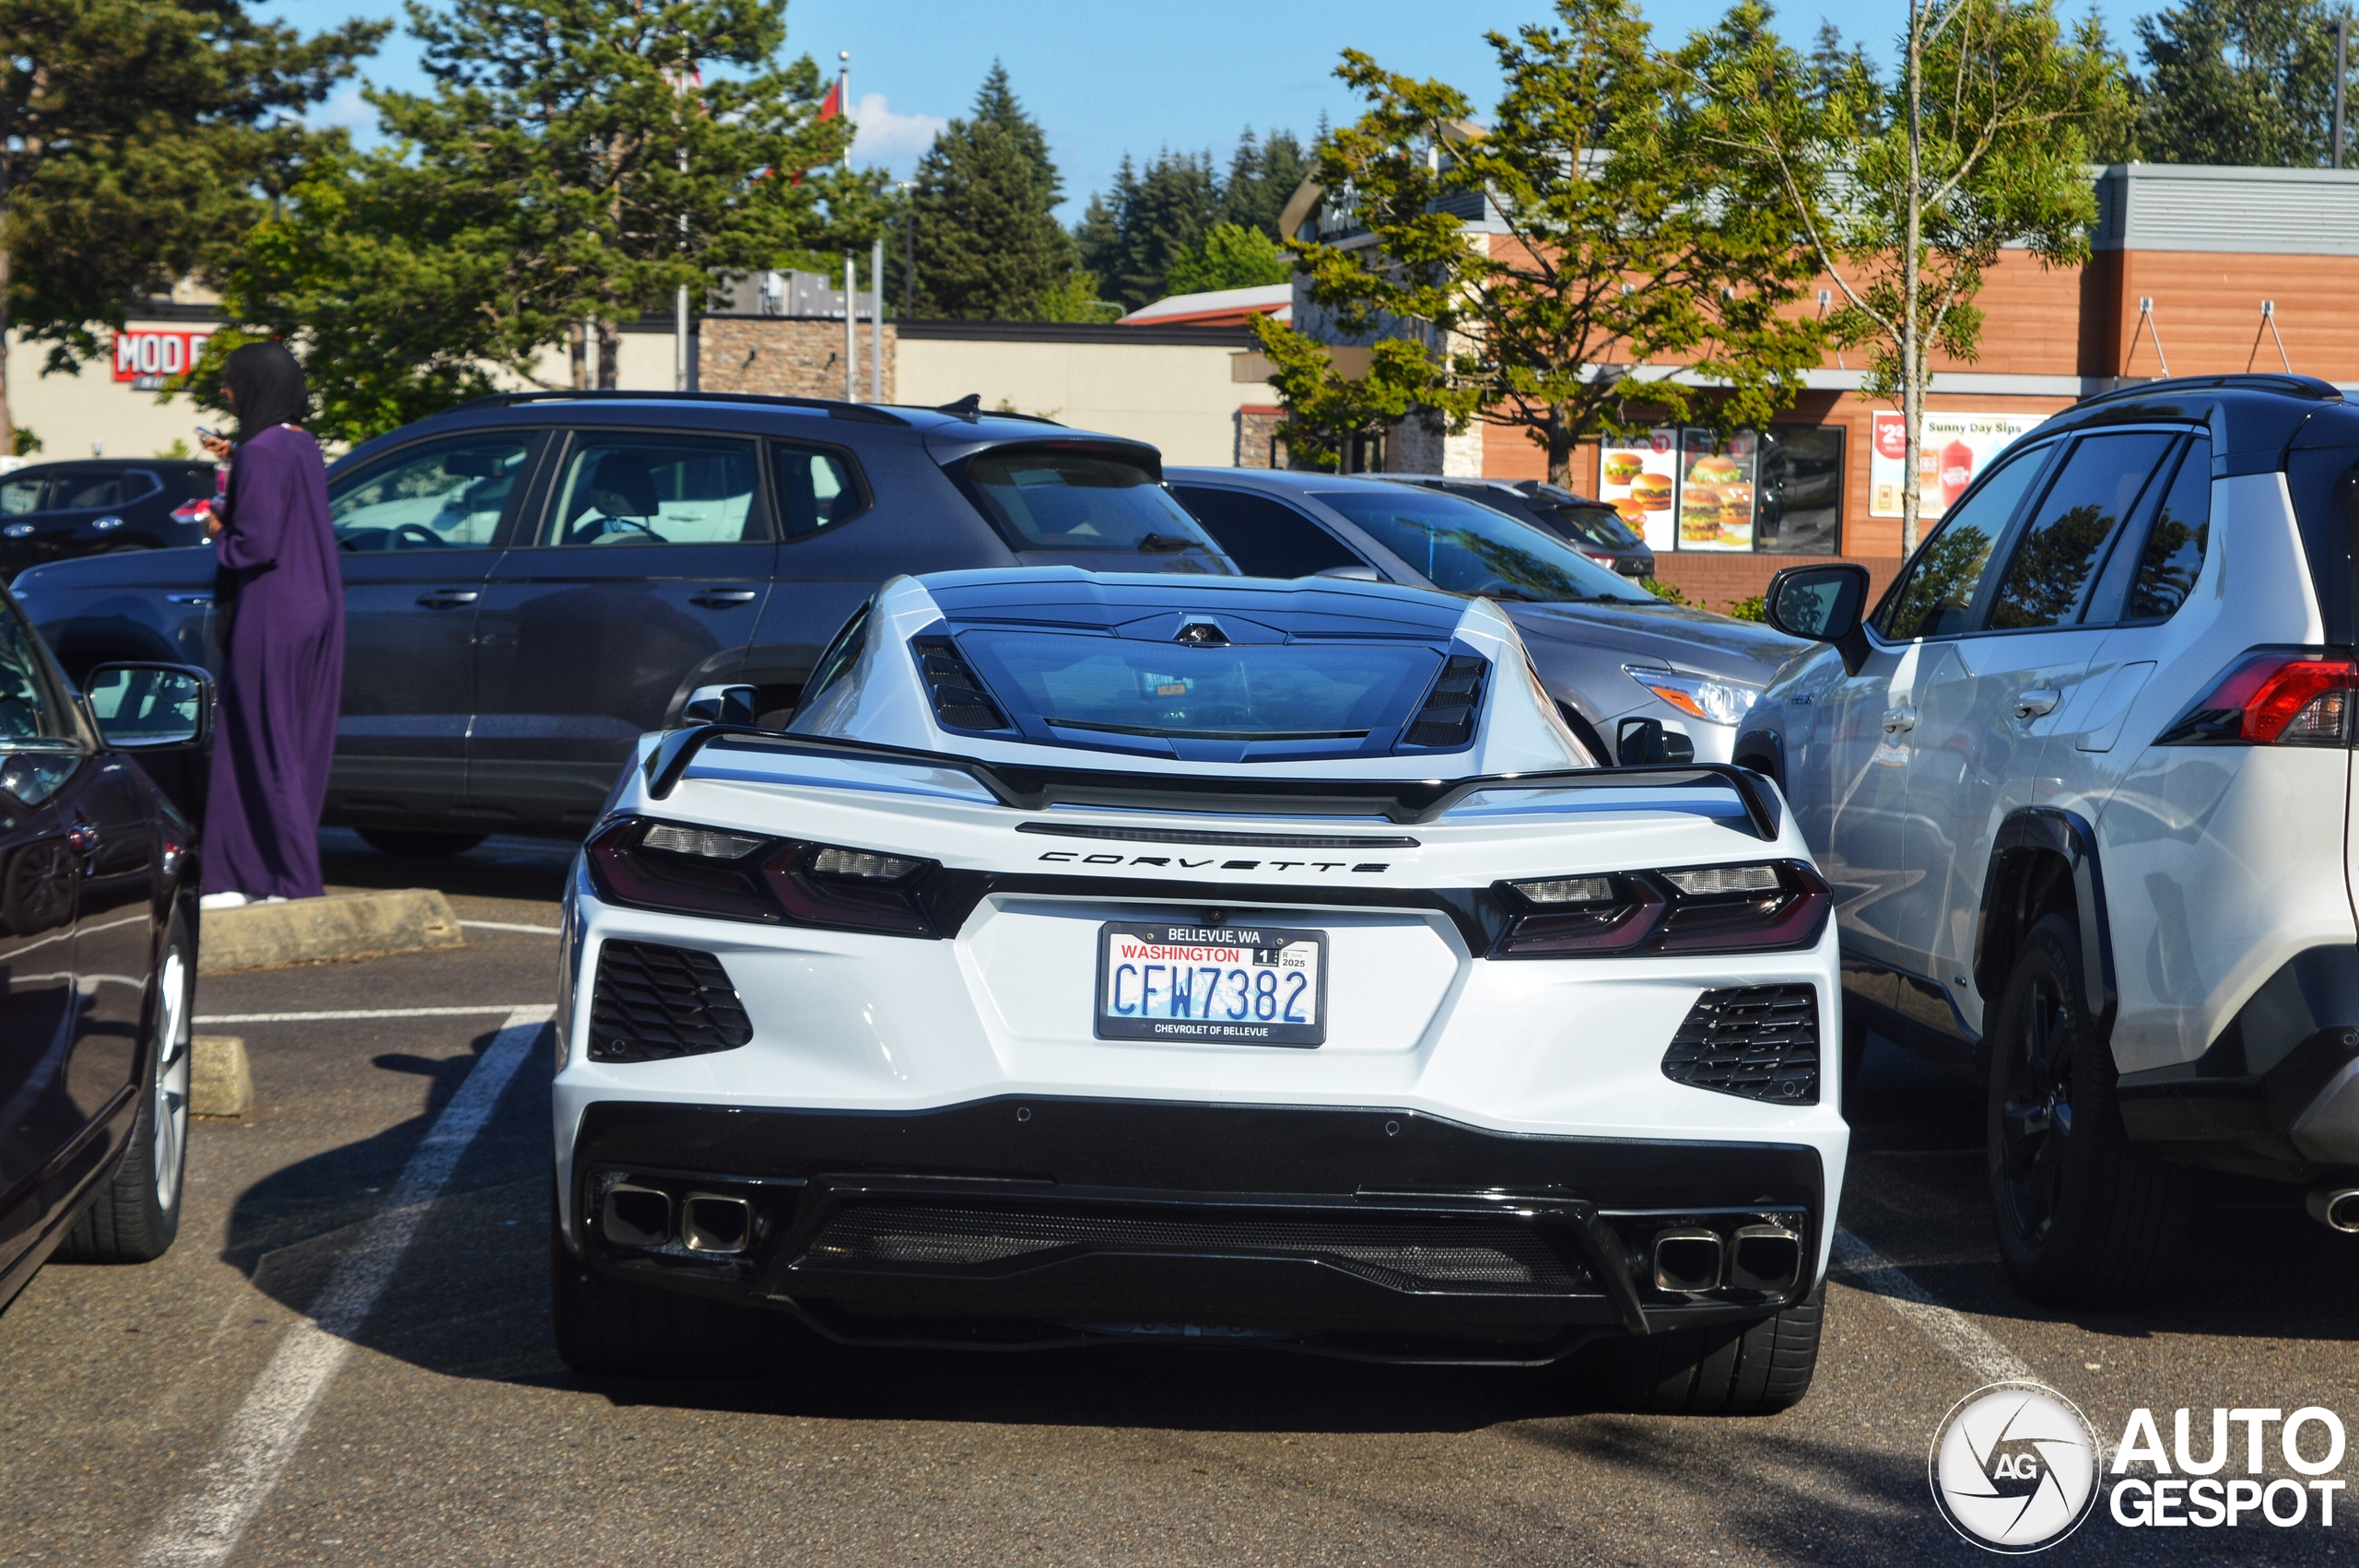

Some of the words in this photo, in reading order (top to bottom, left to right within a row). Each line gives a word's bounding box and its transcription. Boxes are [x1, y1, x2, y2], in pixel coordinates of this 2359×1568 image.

[117, 333, 183, 374] MOD
[1929, 422, 1966, 434] Sunny
[1970, 423, 1992, 434] Day
[1995, 422, 2022, 435] Sips
[1038, 851, 1391, 872] CORVETTE
[1168, 928, 1237, 945] BELLEVUE,
[1238, 931, 1261, 943] WA
[1121, 944, 1239, 963] WASHINGTON
[1260, 950, 1268, 963] 1
[1282, 959, 1306, 967] 2025
[1114, 963, 1309, 1024] CFW7382
[1155, 1024, 1208, 1035] CHEVROLET
[1209, 1025, 1222, 1036] OF
[1223, 1026, 1269, 1036] BELLEVUE
